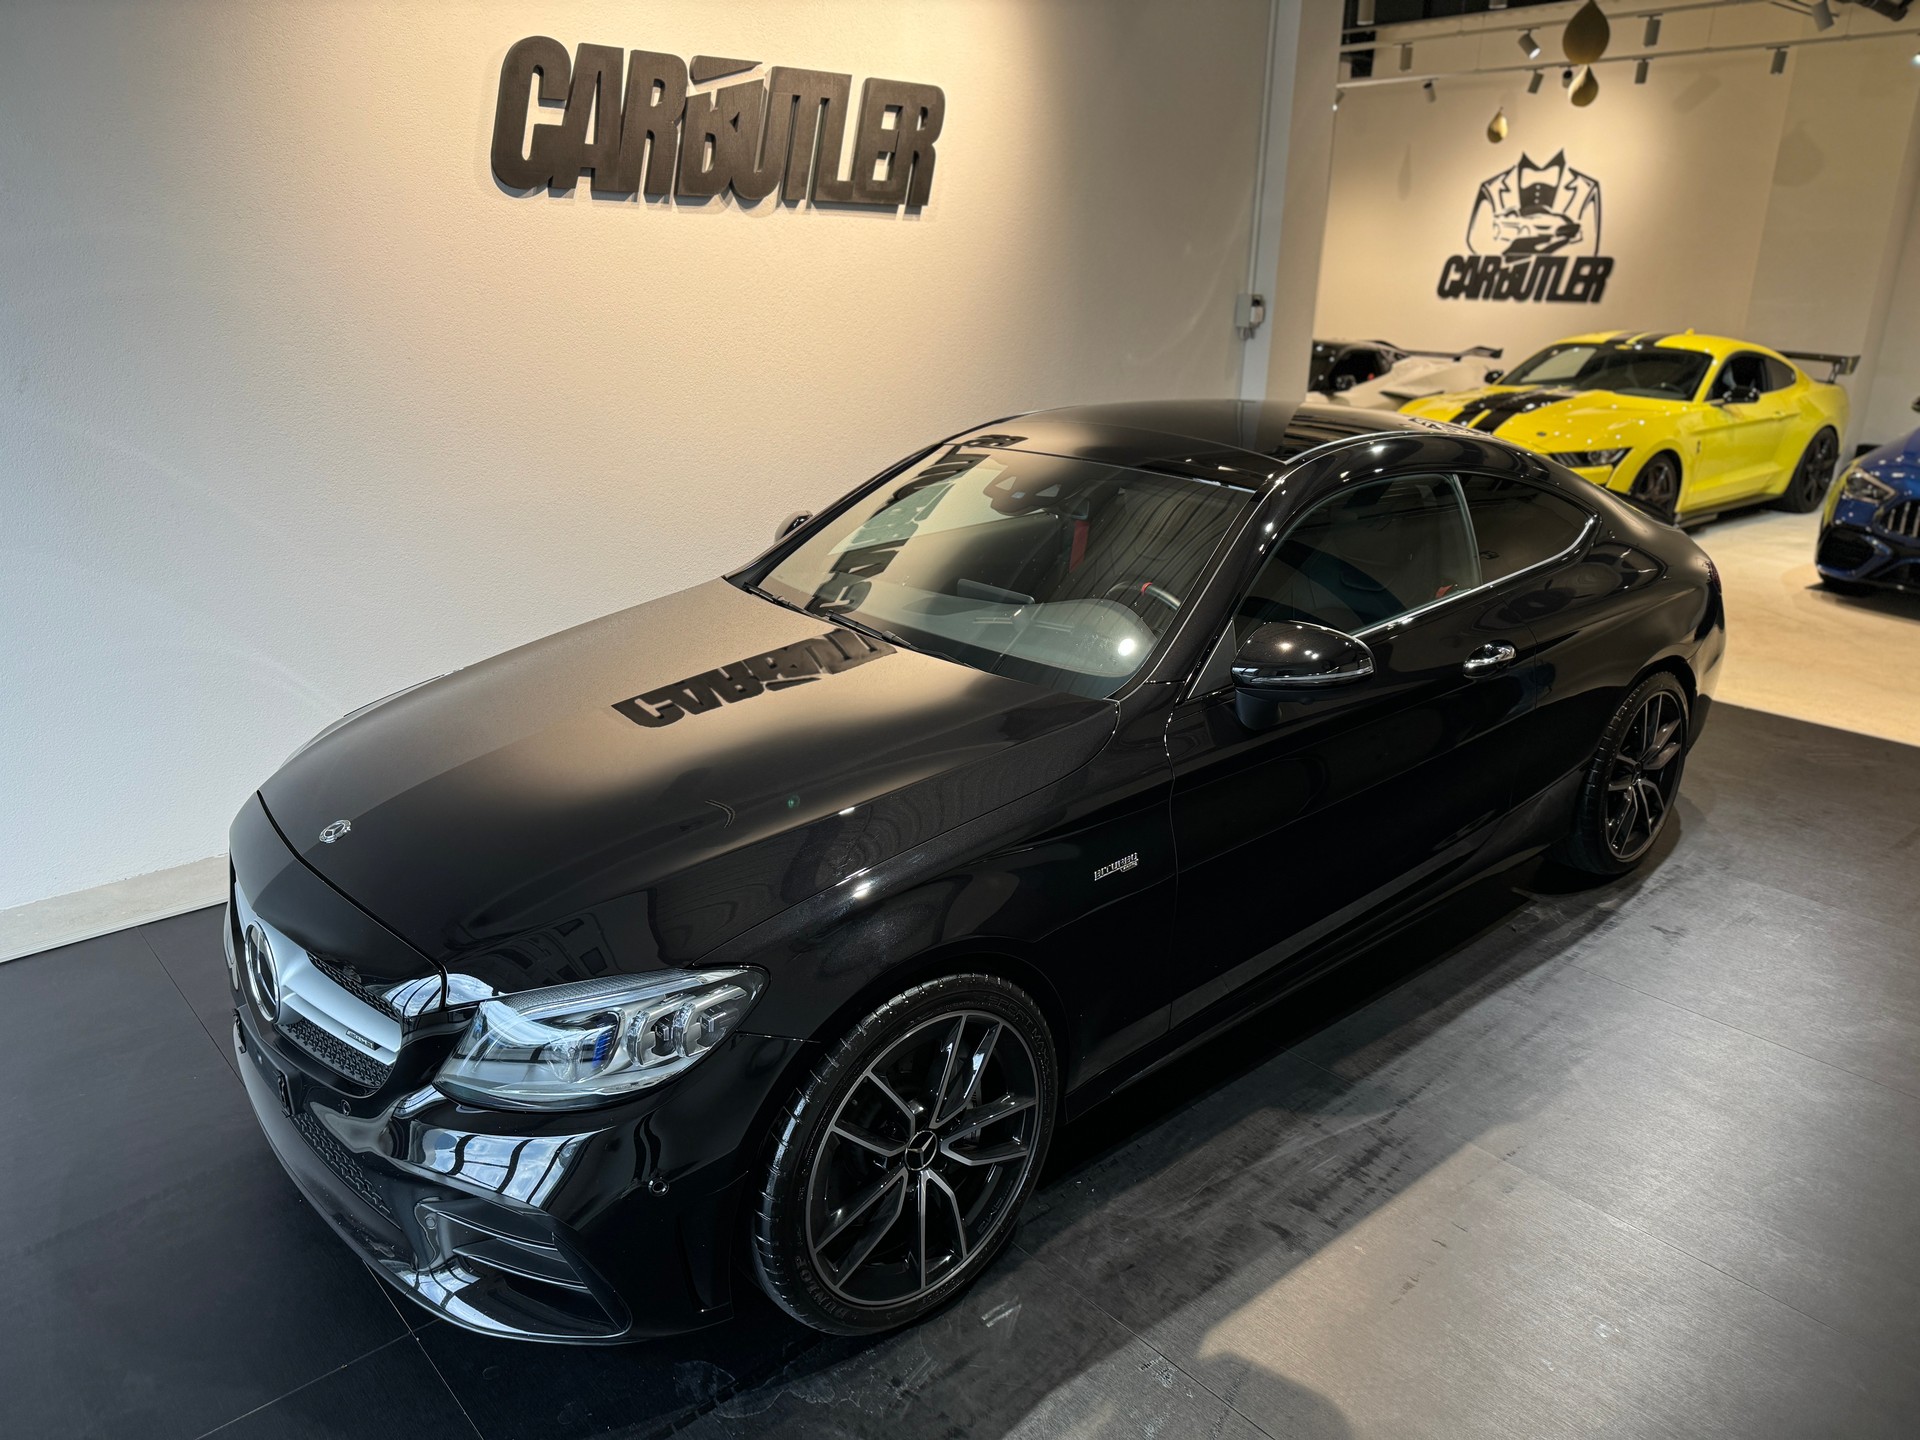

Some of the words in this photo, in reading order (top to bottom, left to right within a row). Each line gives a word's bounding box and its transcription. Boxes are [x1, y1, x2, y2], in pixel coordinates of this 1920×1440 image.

[491, 36, 946, 207] CARBUTLER
[1437, 254, 1614, 303] CARBUTLER
[988, 995, 1034, 1030] SPORT
